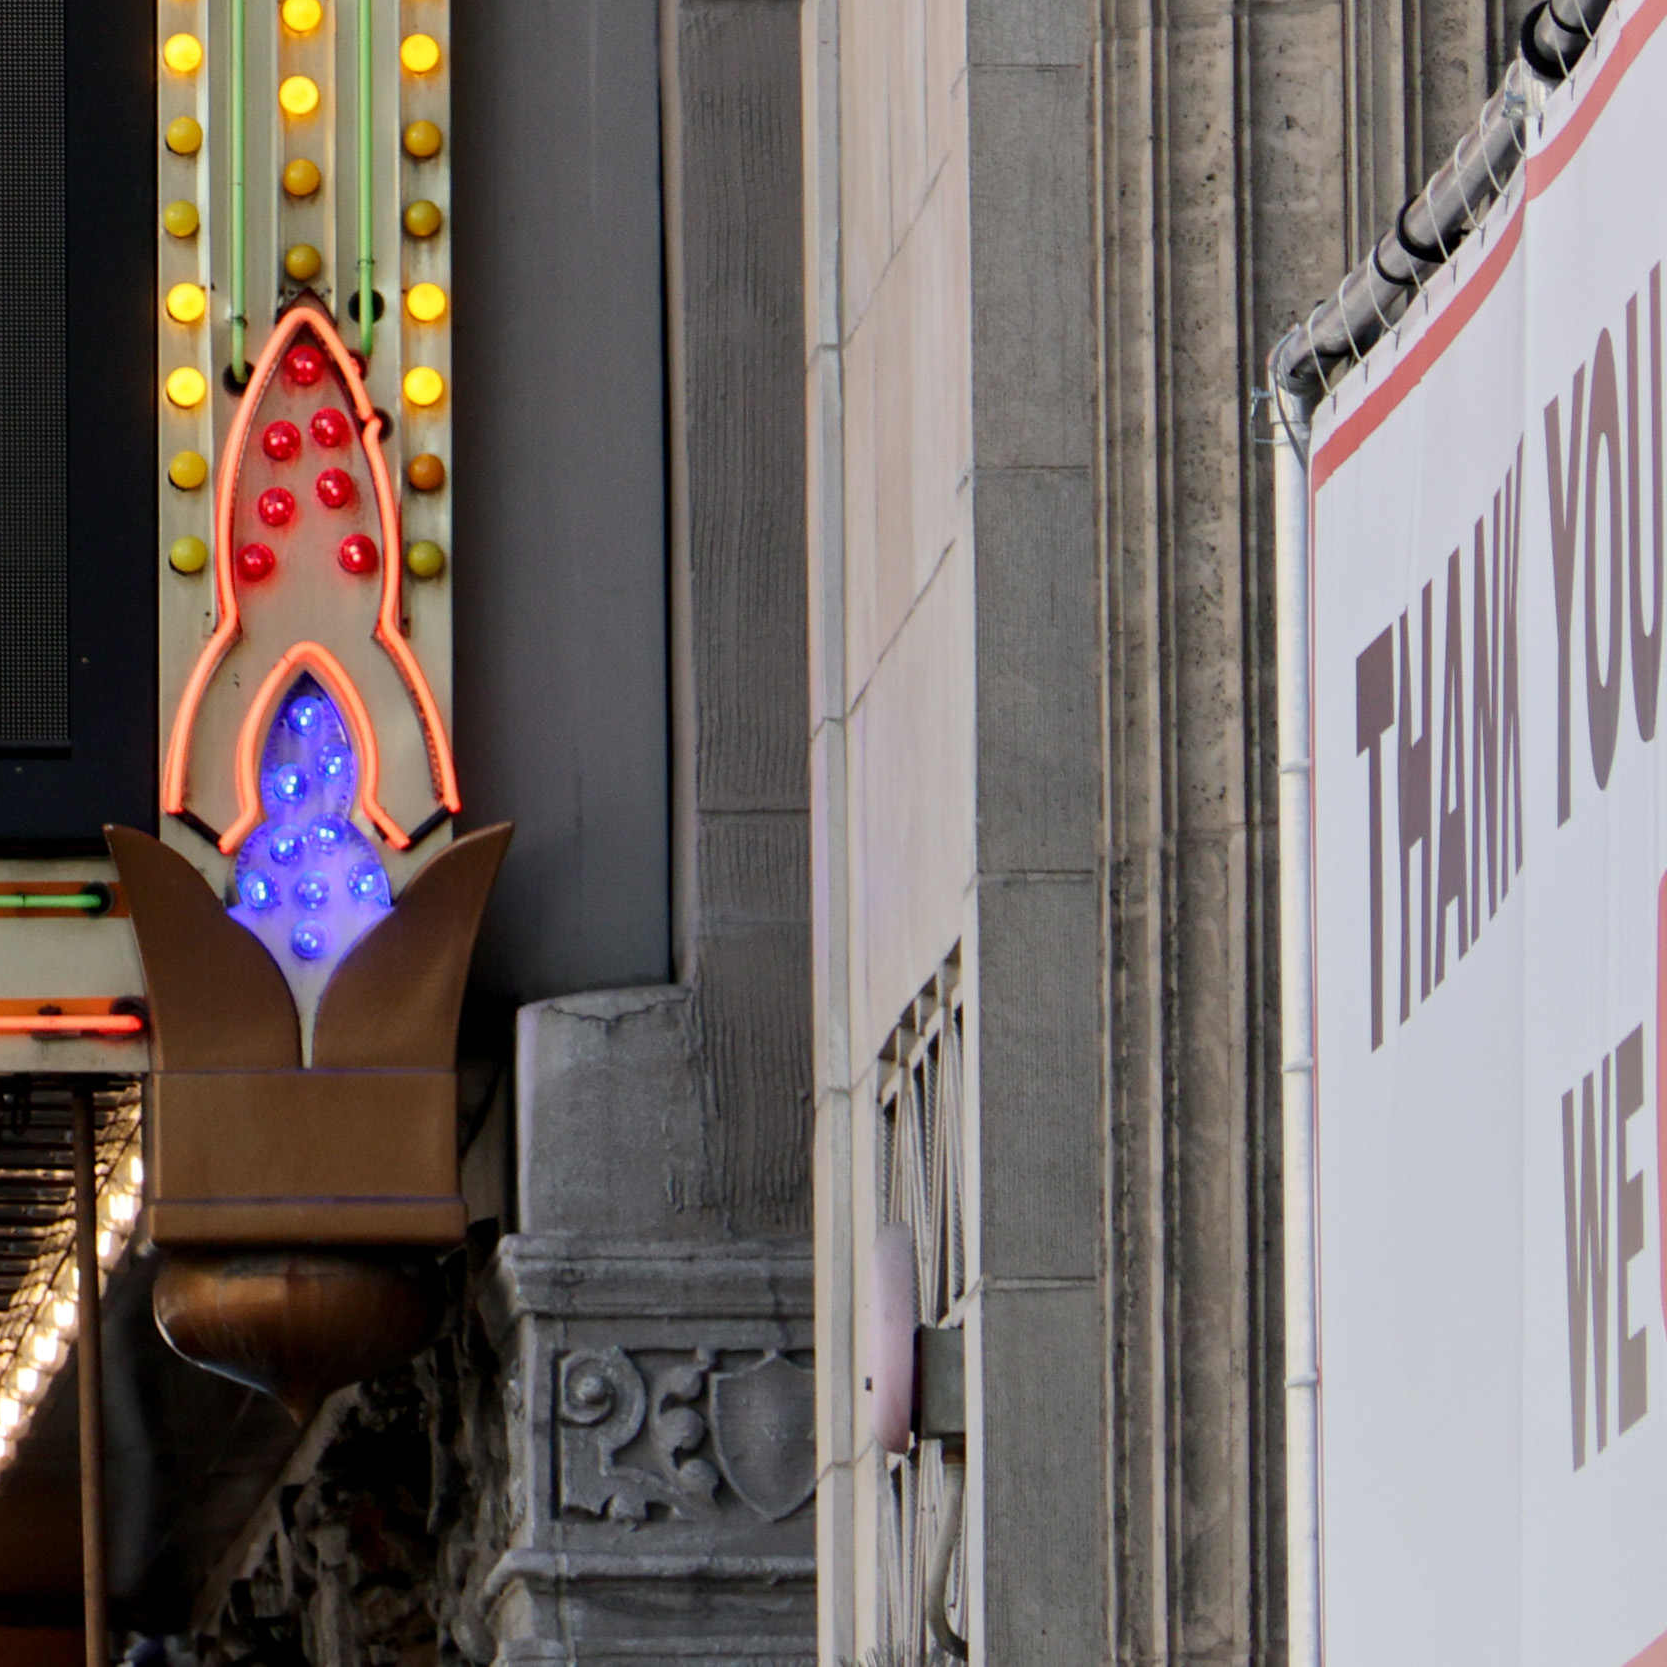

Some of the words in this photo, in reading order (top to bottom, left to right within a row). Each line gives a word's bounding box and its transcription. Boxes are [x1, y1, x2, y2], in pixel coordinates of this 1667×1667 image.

[1356, 431, 1524, 1053] THANK
[1544, 260, 1664, 829] YOU
[1561, 1021, 1647, 1473] WE
